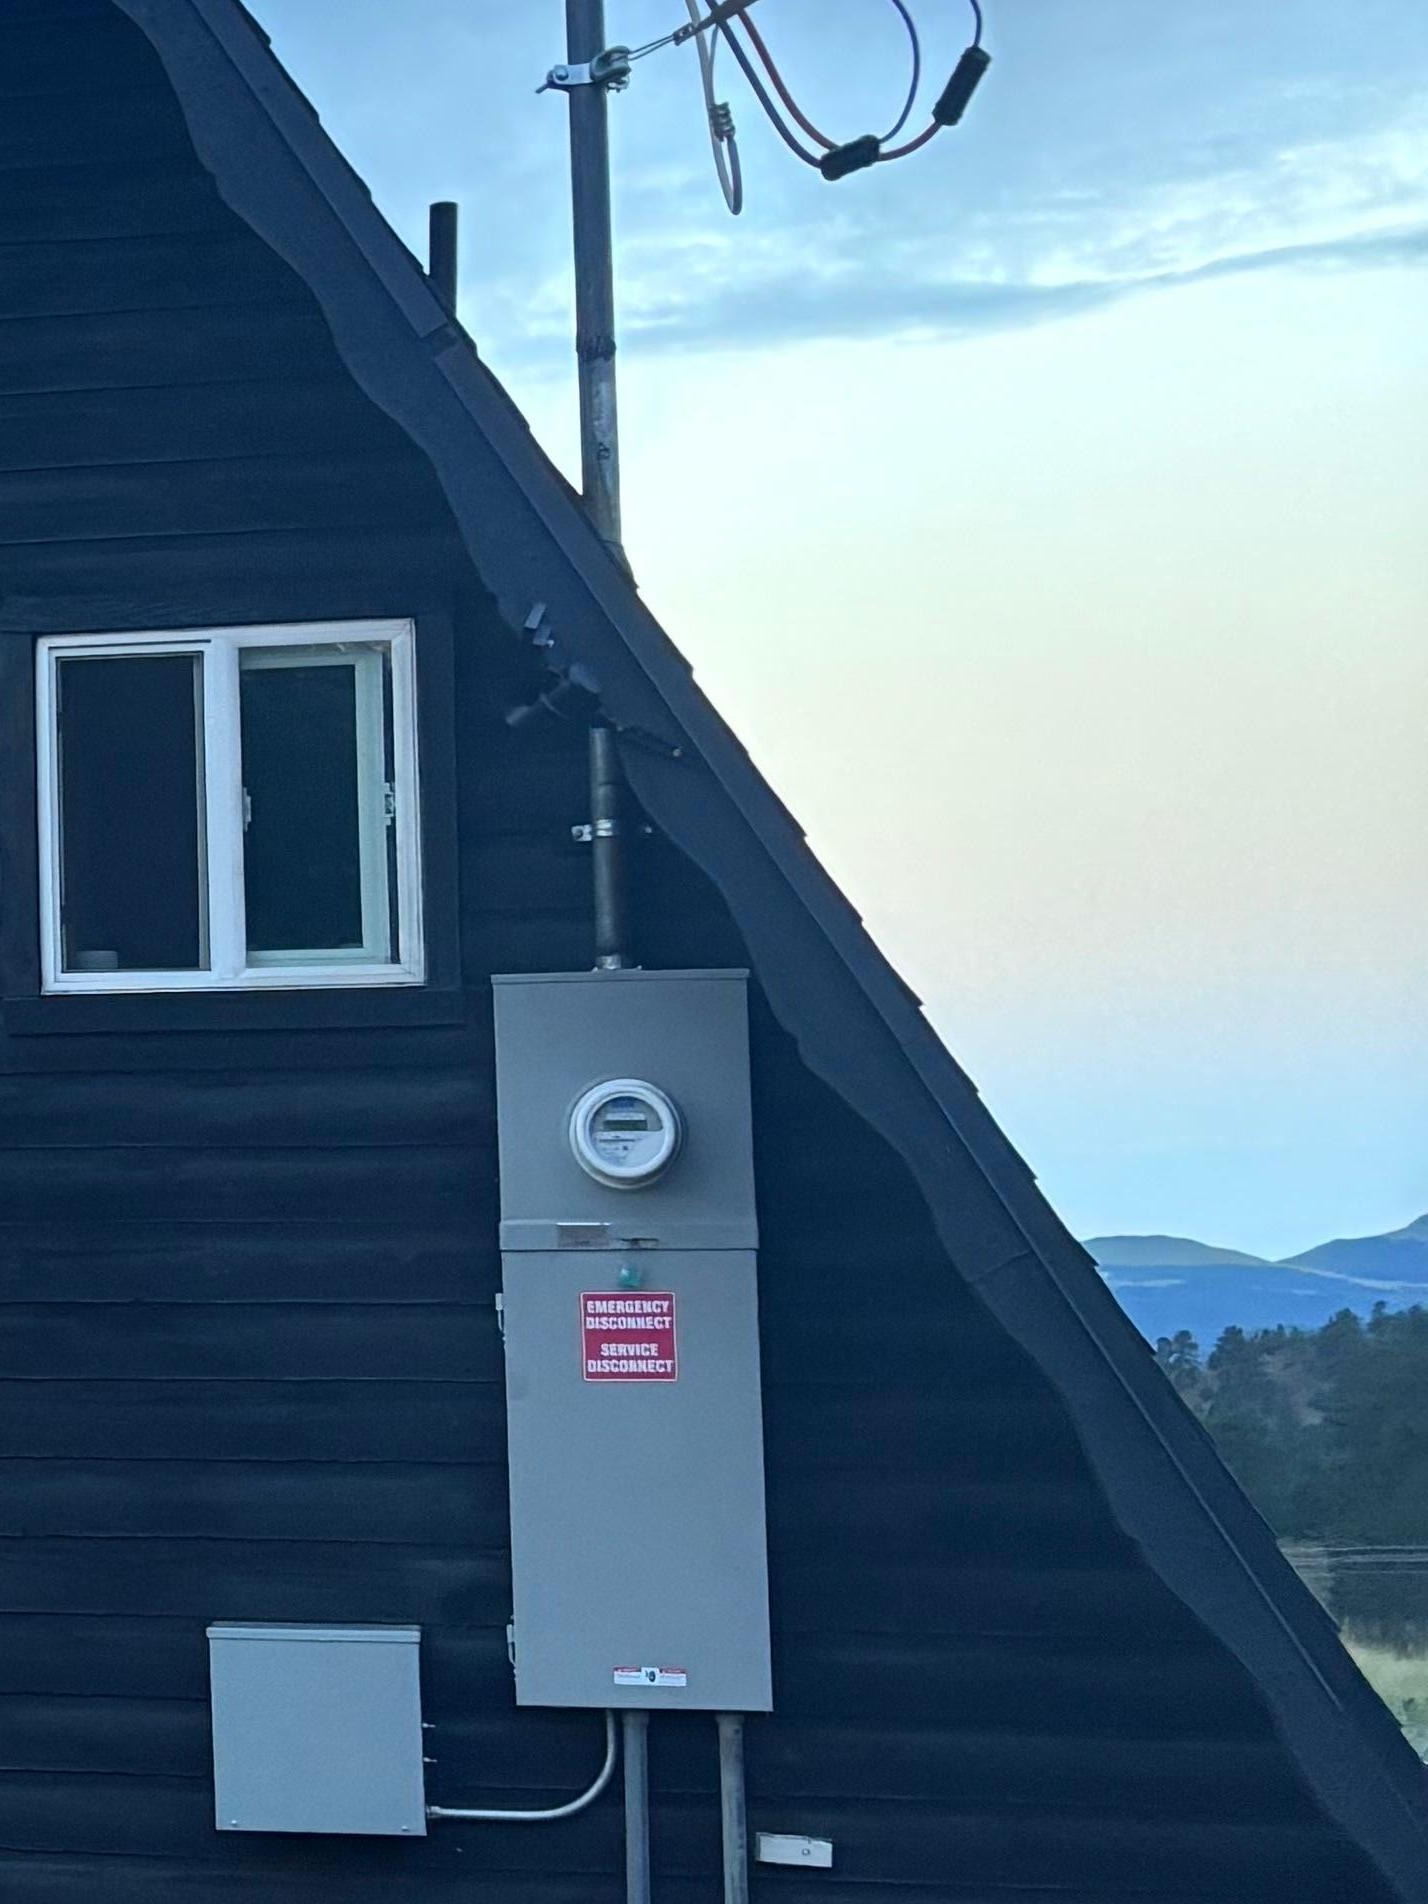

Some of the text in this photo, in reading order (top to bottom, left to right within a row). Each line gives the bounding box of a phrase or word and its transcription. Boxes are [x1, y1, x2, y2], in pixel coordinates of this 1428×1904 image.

[586, 1300, 669, 1313] EMERGENCY
[585, 1316, 672, 1330] DISCONNECT
[600, 1343, 659, 1356] SERVICE
[587, 1359, 674, 1373] DISCONNECT
